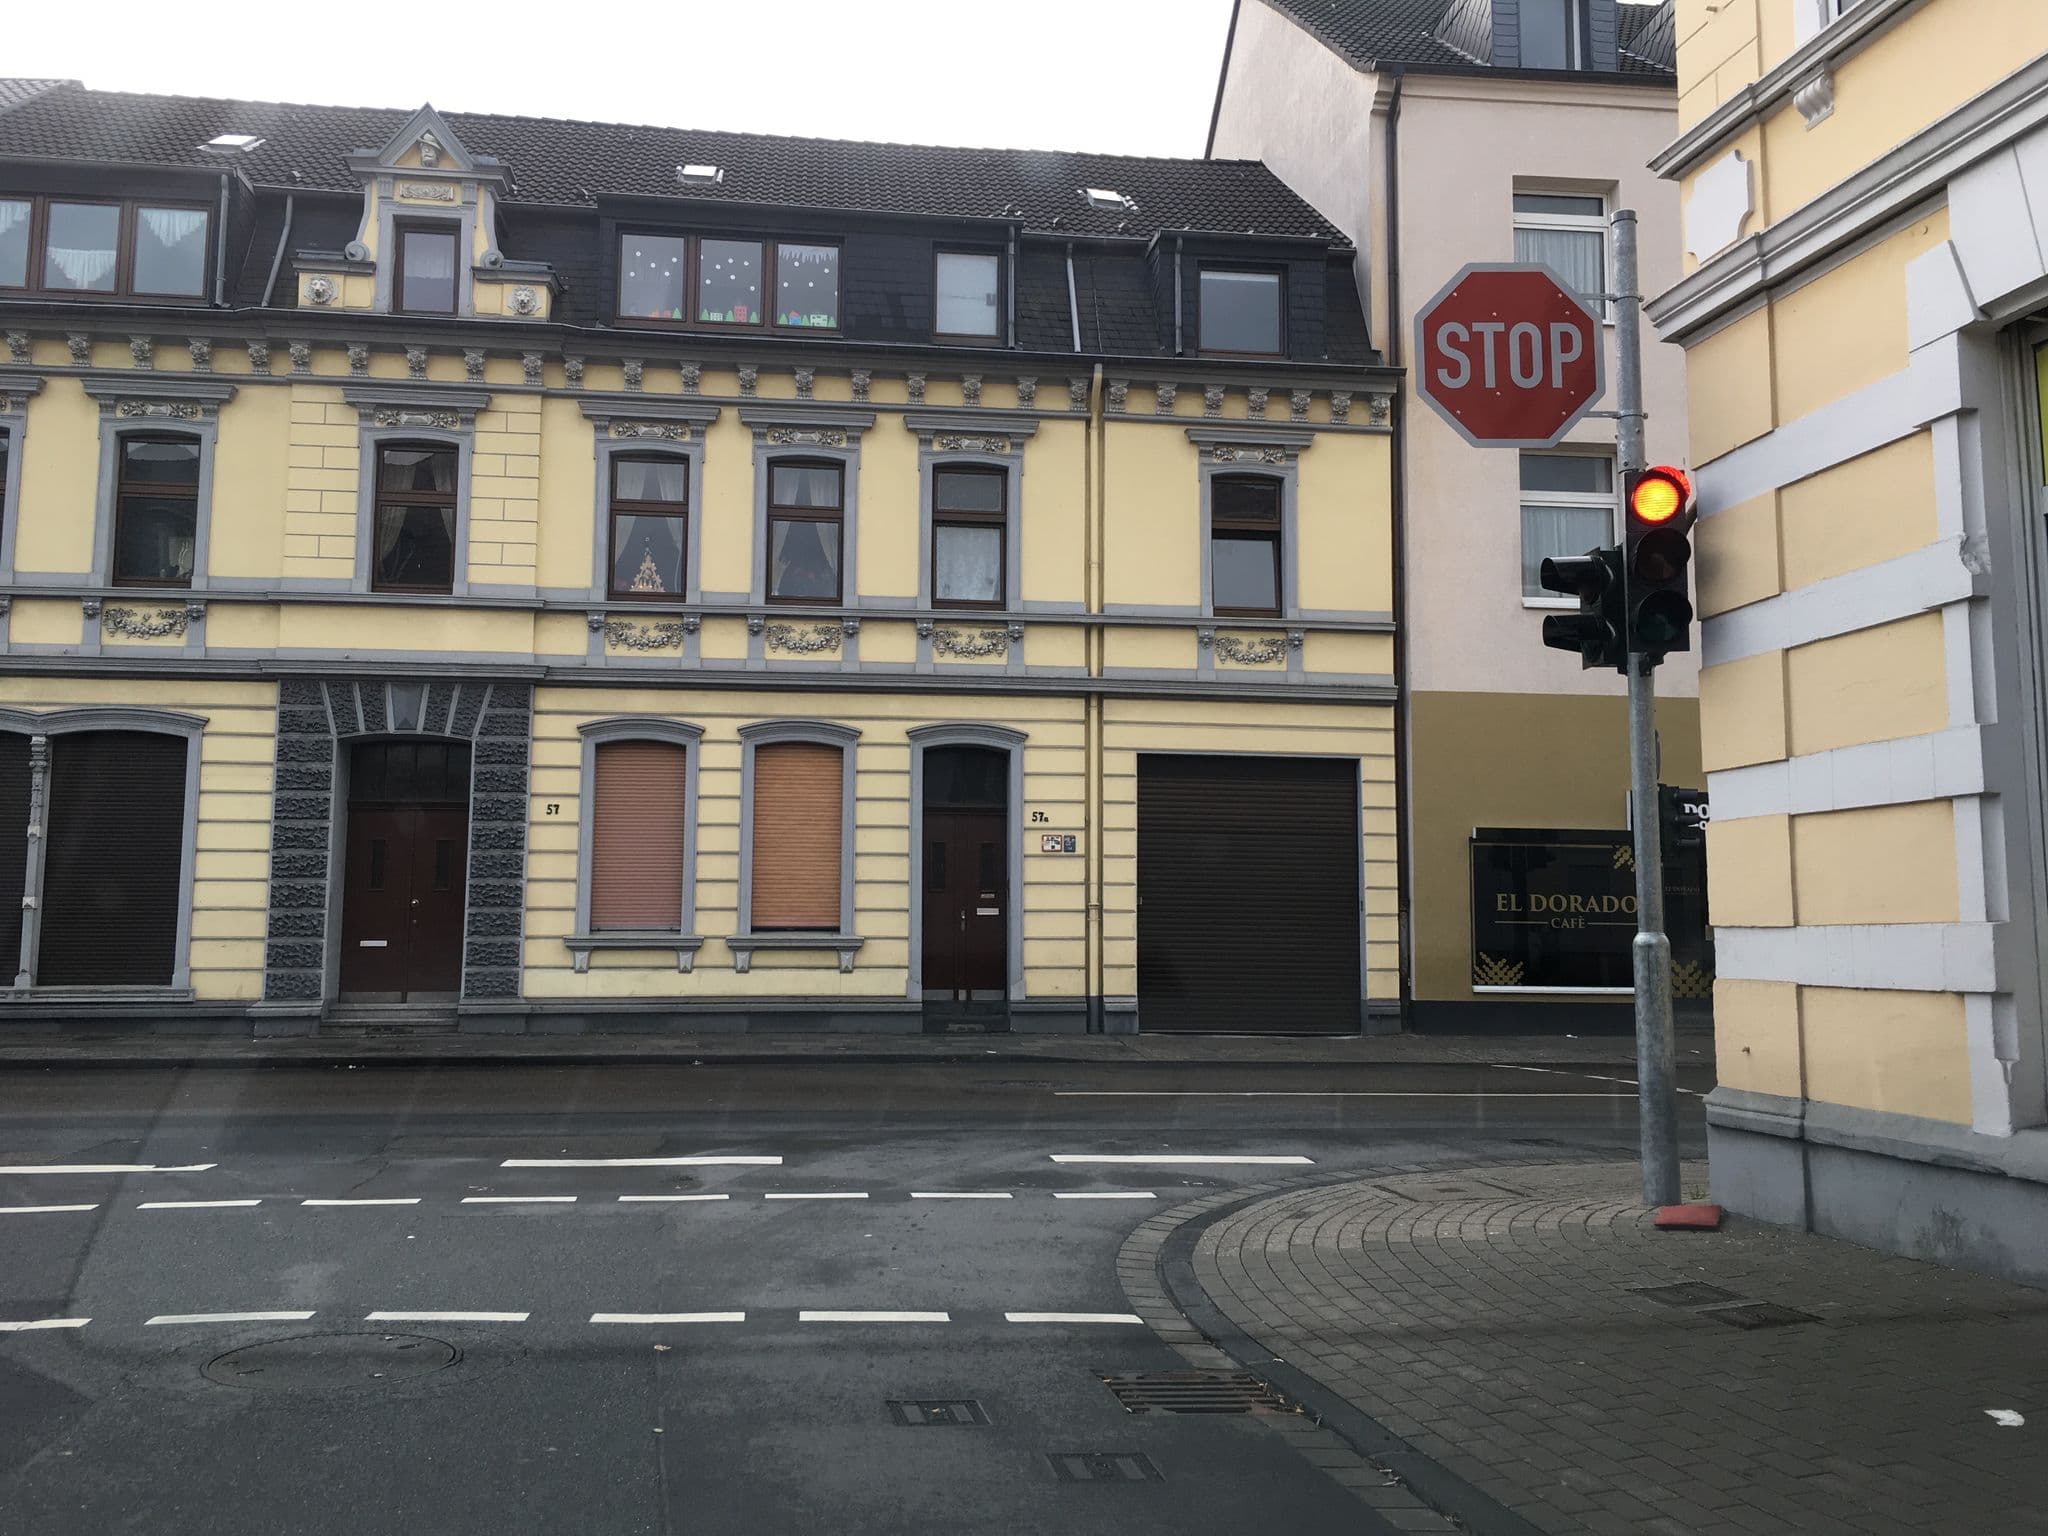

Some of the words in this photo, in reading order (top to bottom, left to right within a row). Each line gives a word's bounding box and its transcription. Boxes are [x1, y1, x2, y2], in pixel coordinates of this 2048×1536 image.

[1437, 322, 1583, 389] STOP
[546, 804, 560, 815] 57
[1032, 811, 1049, 822] 57a
[1496, 893, 1523, 912] EL
[1529, 894, 1638, 913] DORADO
